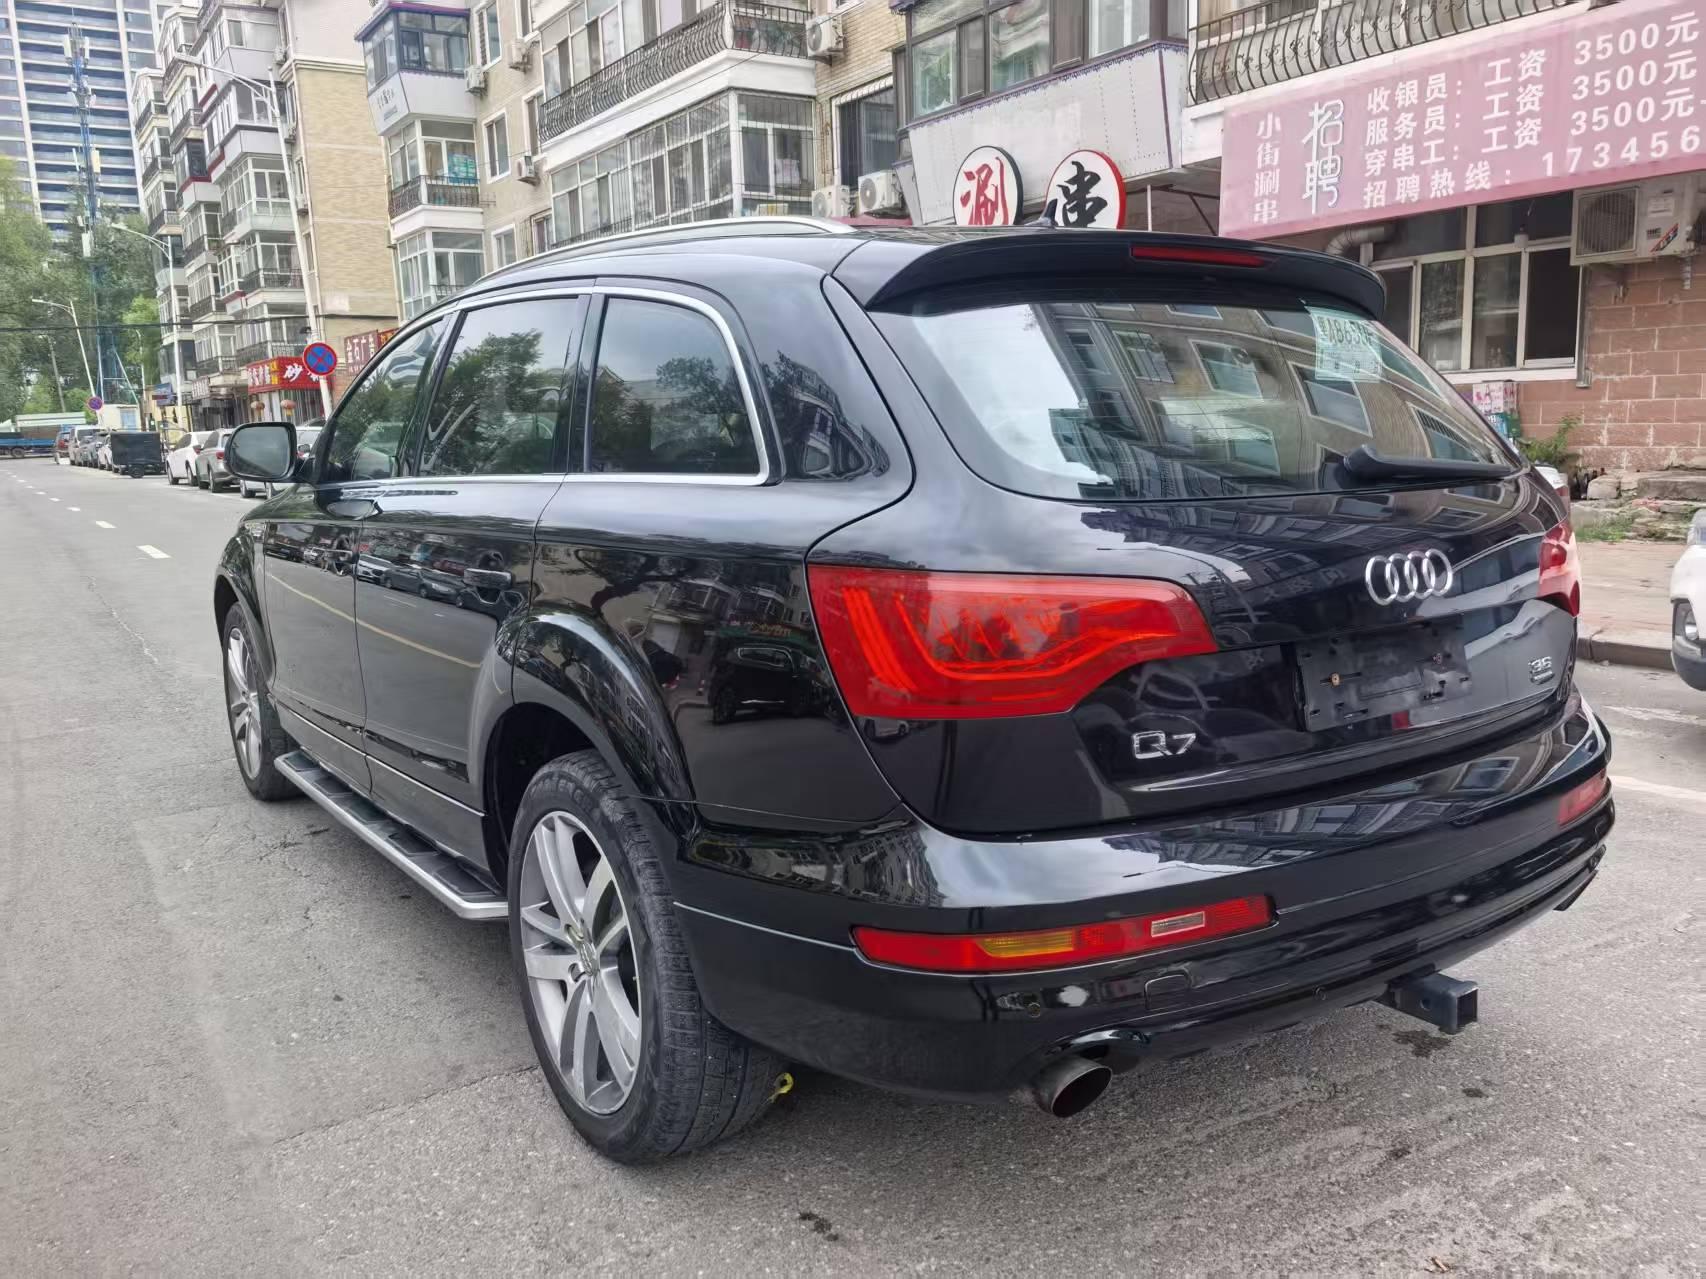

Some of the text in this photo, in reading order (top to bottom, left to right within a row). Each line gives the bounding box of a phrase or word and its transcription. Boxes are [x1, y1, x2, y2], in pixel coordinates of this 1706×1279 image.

[1482, 84, 1544, 120] 工资
[1571, 49, 1697, 101] 3500元
[1484, 48, 1547, 88] 工资
[1573, 11, 1699, 65] 3500元
[1301, 98, 1344, 215] 招聘
[1481, 118, 1542, 153] 工资
[1569, 87, 1695, 137] 3500元
[1253, 112, 1281, 224] 小街涮串
[1132, 730, 1197, 760] Q7
